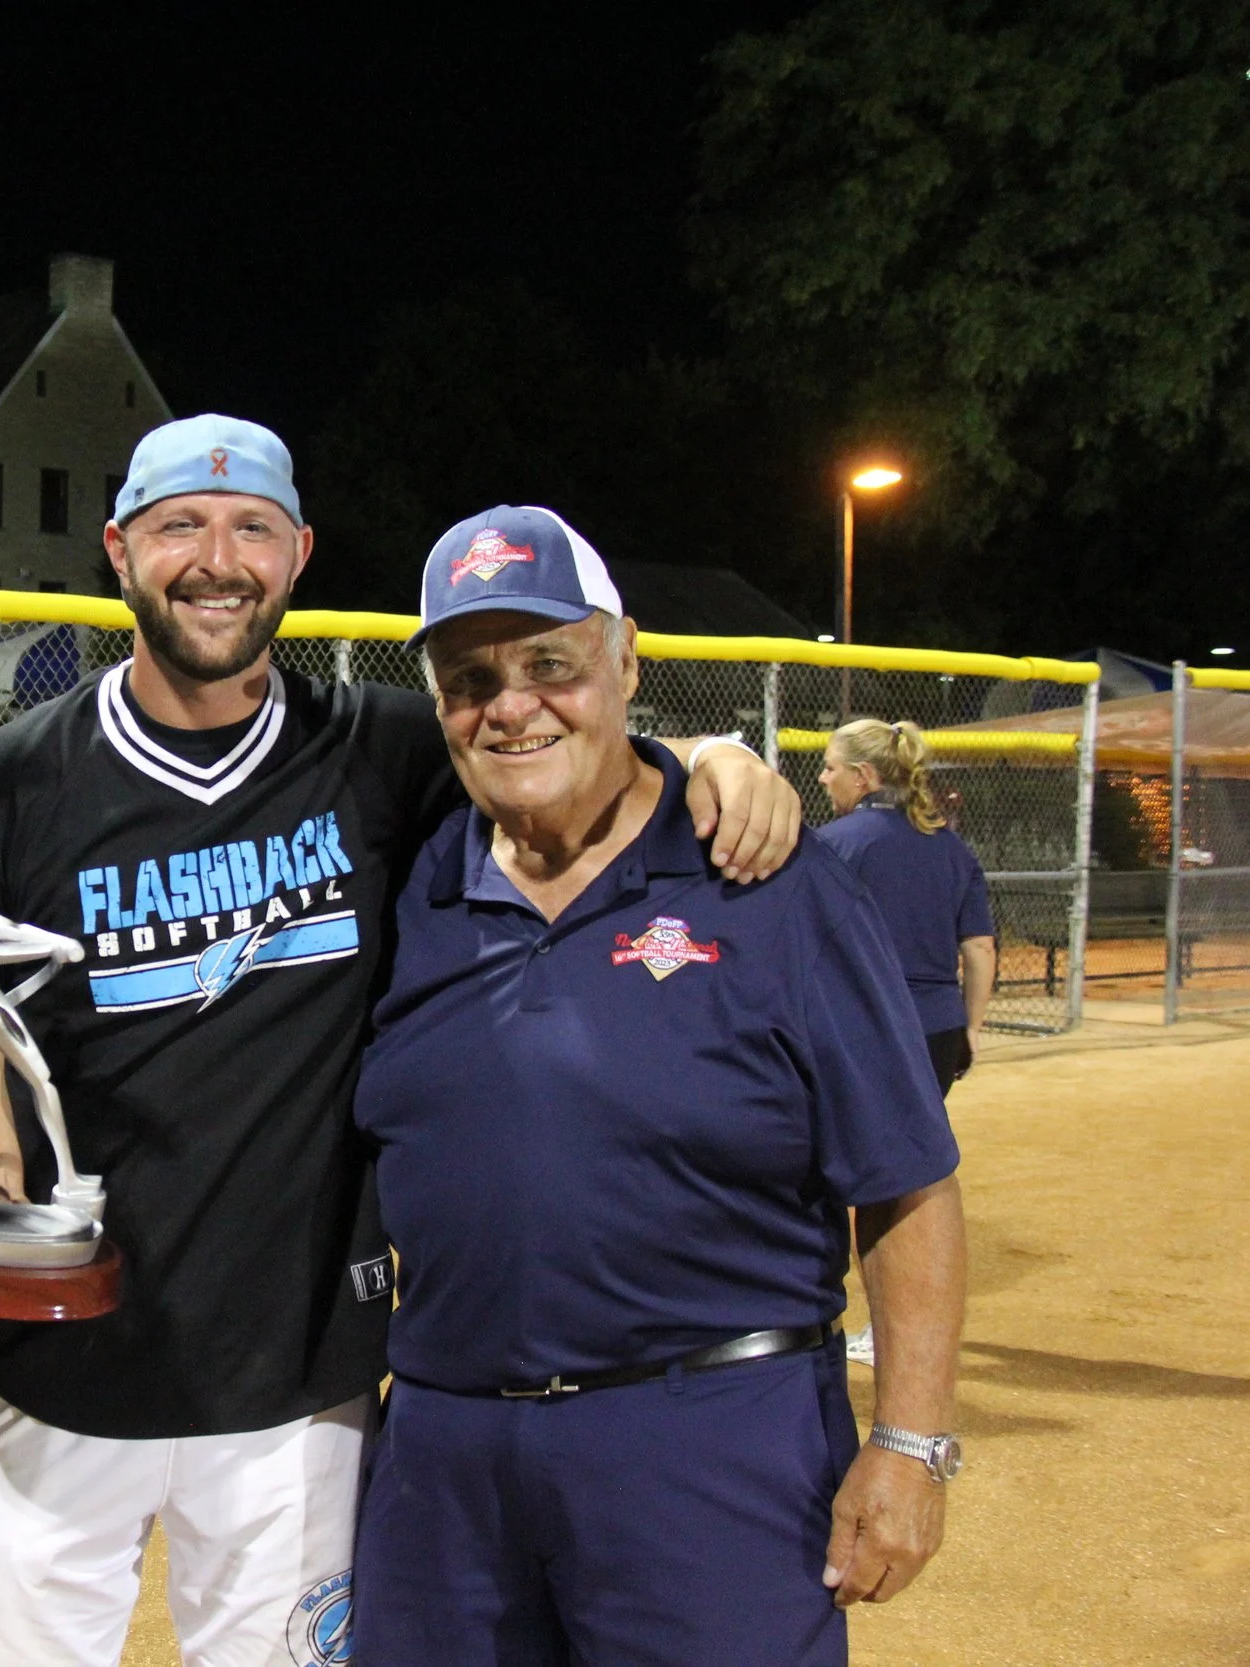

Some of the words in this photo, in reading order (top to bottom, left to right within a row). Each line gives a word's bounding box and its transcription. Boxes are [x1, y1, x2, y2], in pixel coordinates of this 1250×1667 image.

[77, 810, 354, 936] FLASHBACK
[96, 879, 343, 958] SOFTBALL
[626, 949, 662, 960] SOFTBALL
[662, 950, 711, 963] TOURNAMENT
